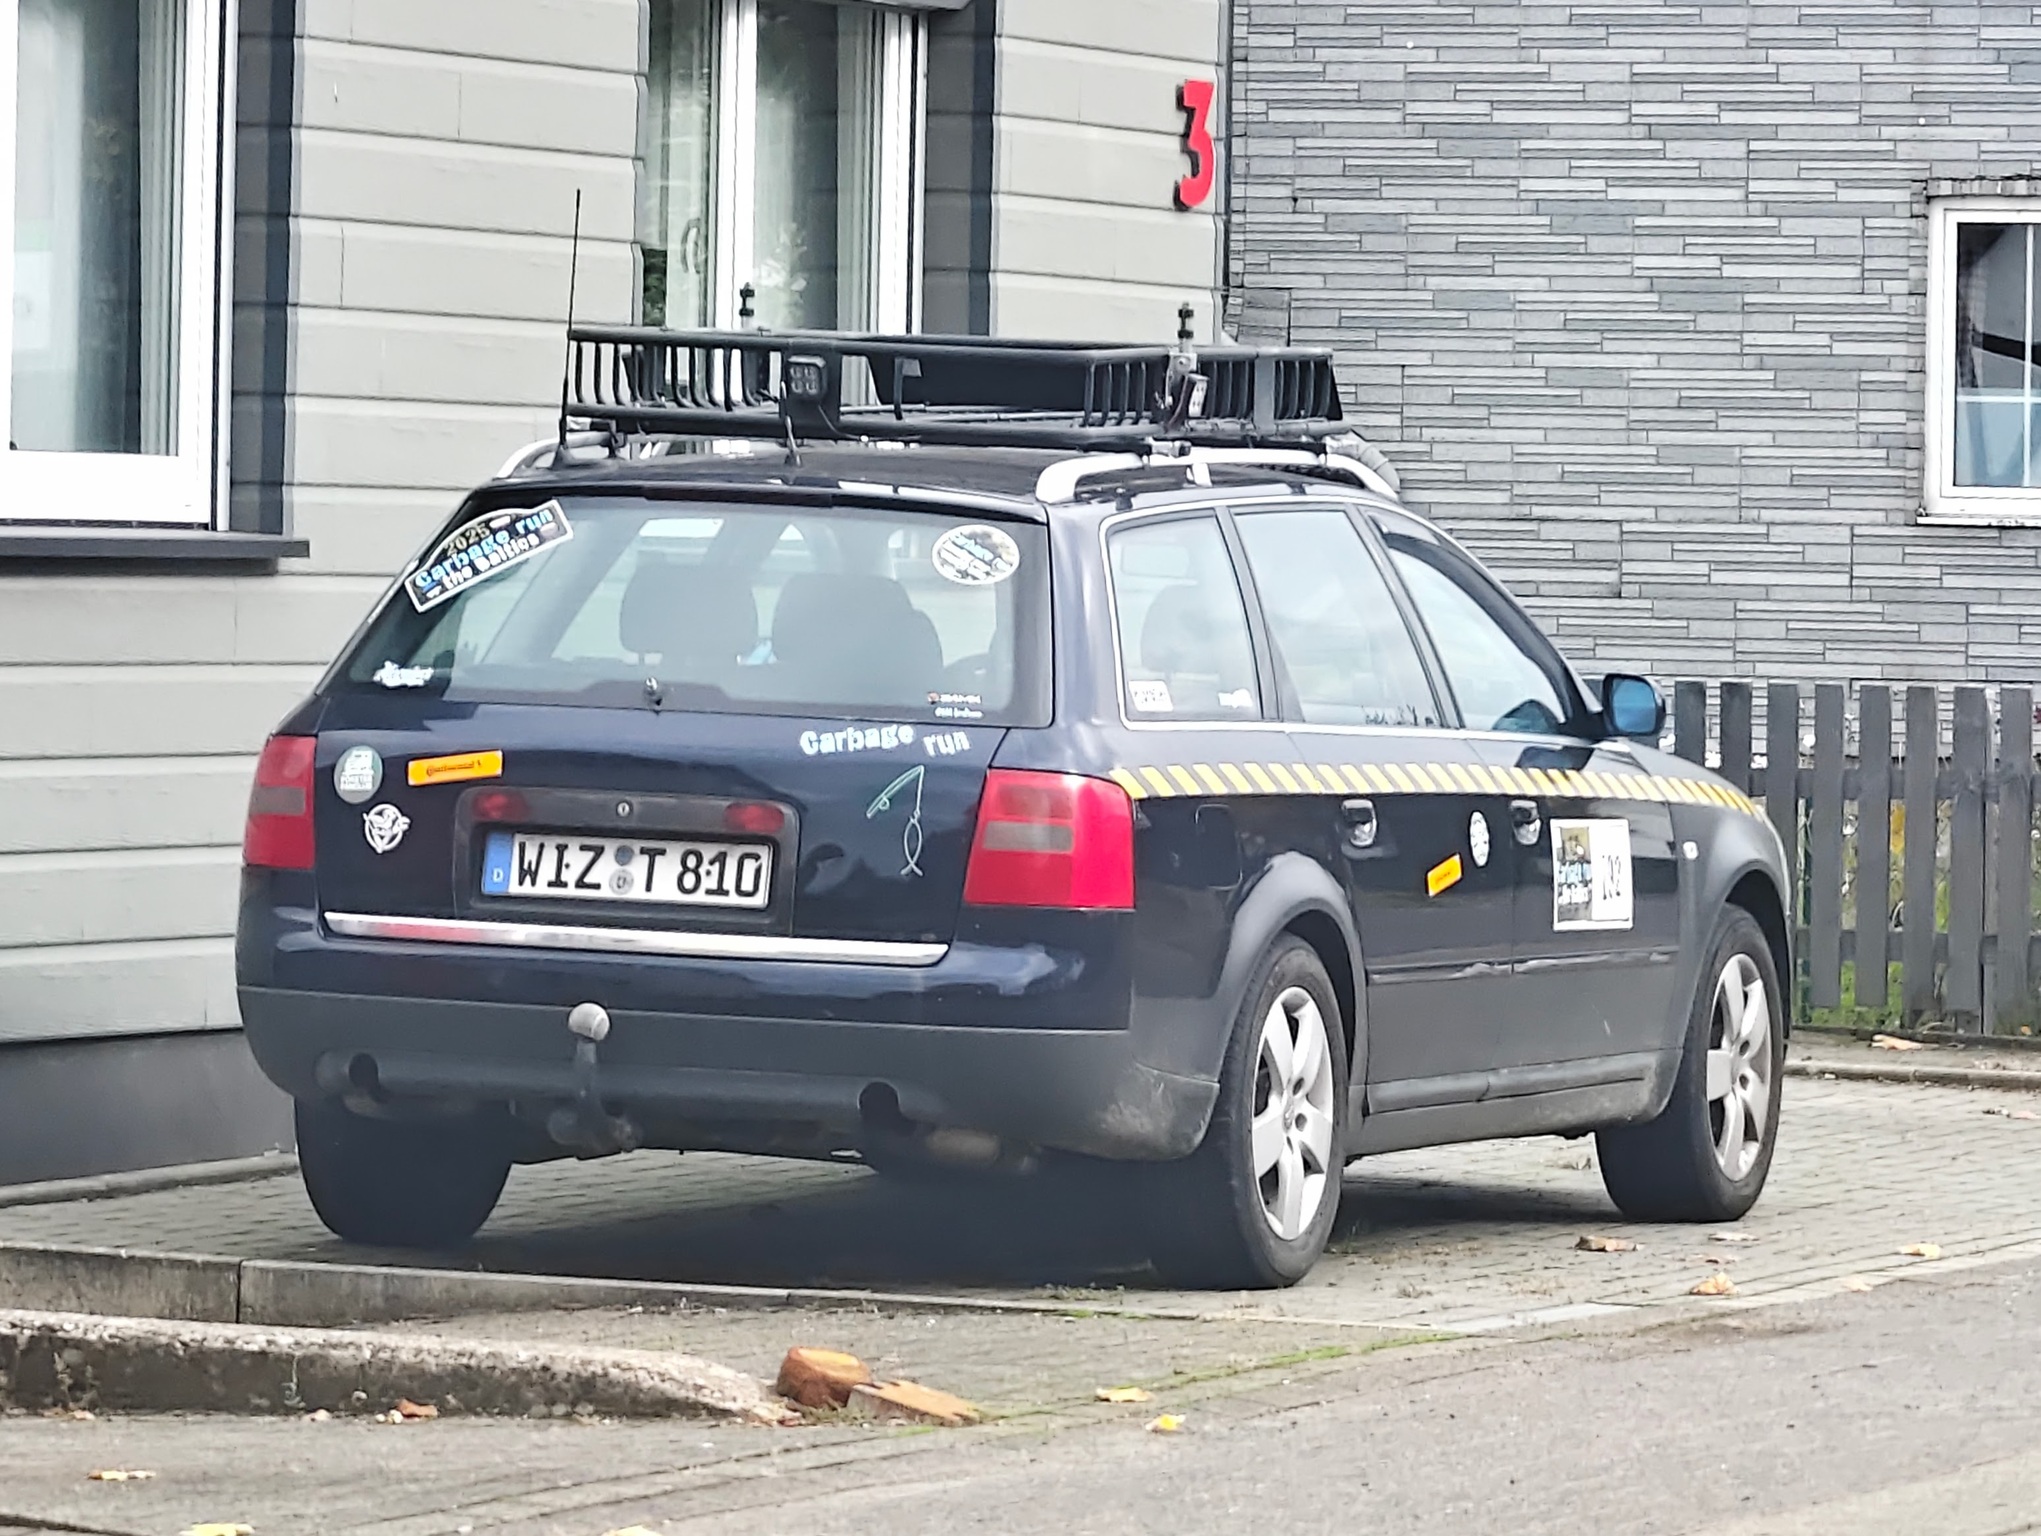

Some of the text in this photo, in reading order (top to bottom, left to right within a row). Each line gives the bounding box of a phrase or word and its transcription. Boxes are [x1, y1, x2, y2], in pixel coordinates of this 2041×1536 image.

[1174, 79, 1214, 211] 3
[515, 509, 554, 535] run
[445, 522, 491, 557] 2025
[442, 566, 473, 590] the
[923, 731, 972, 757] run
[492, 868, 504, 883] D
